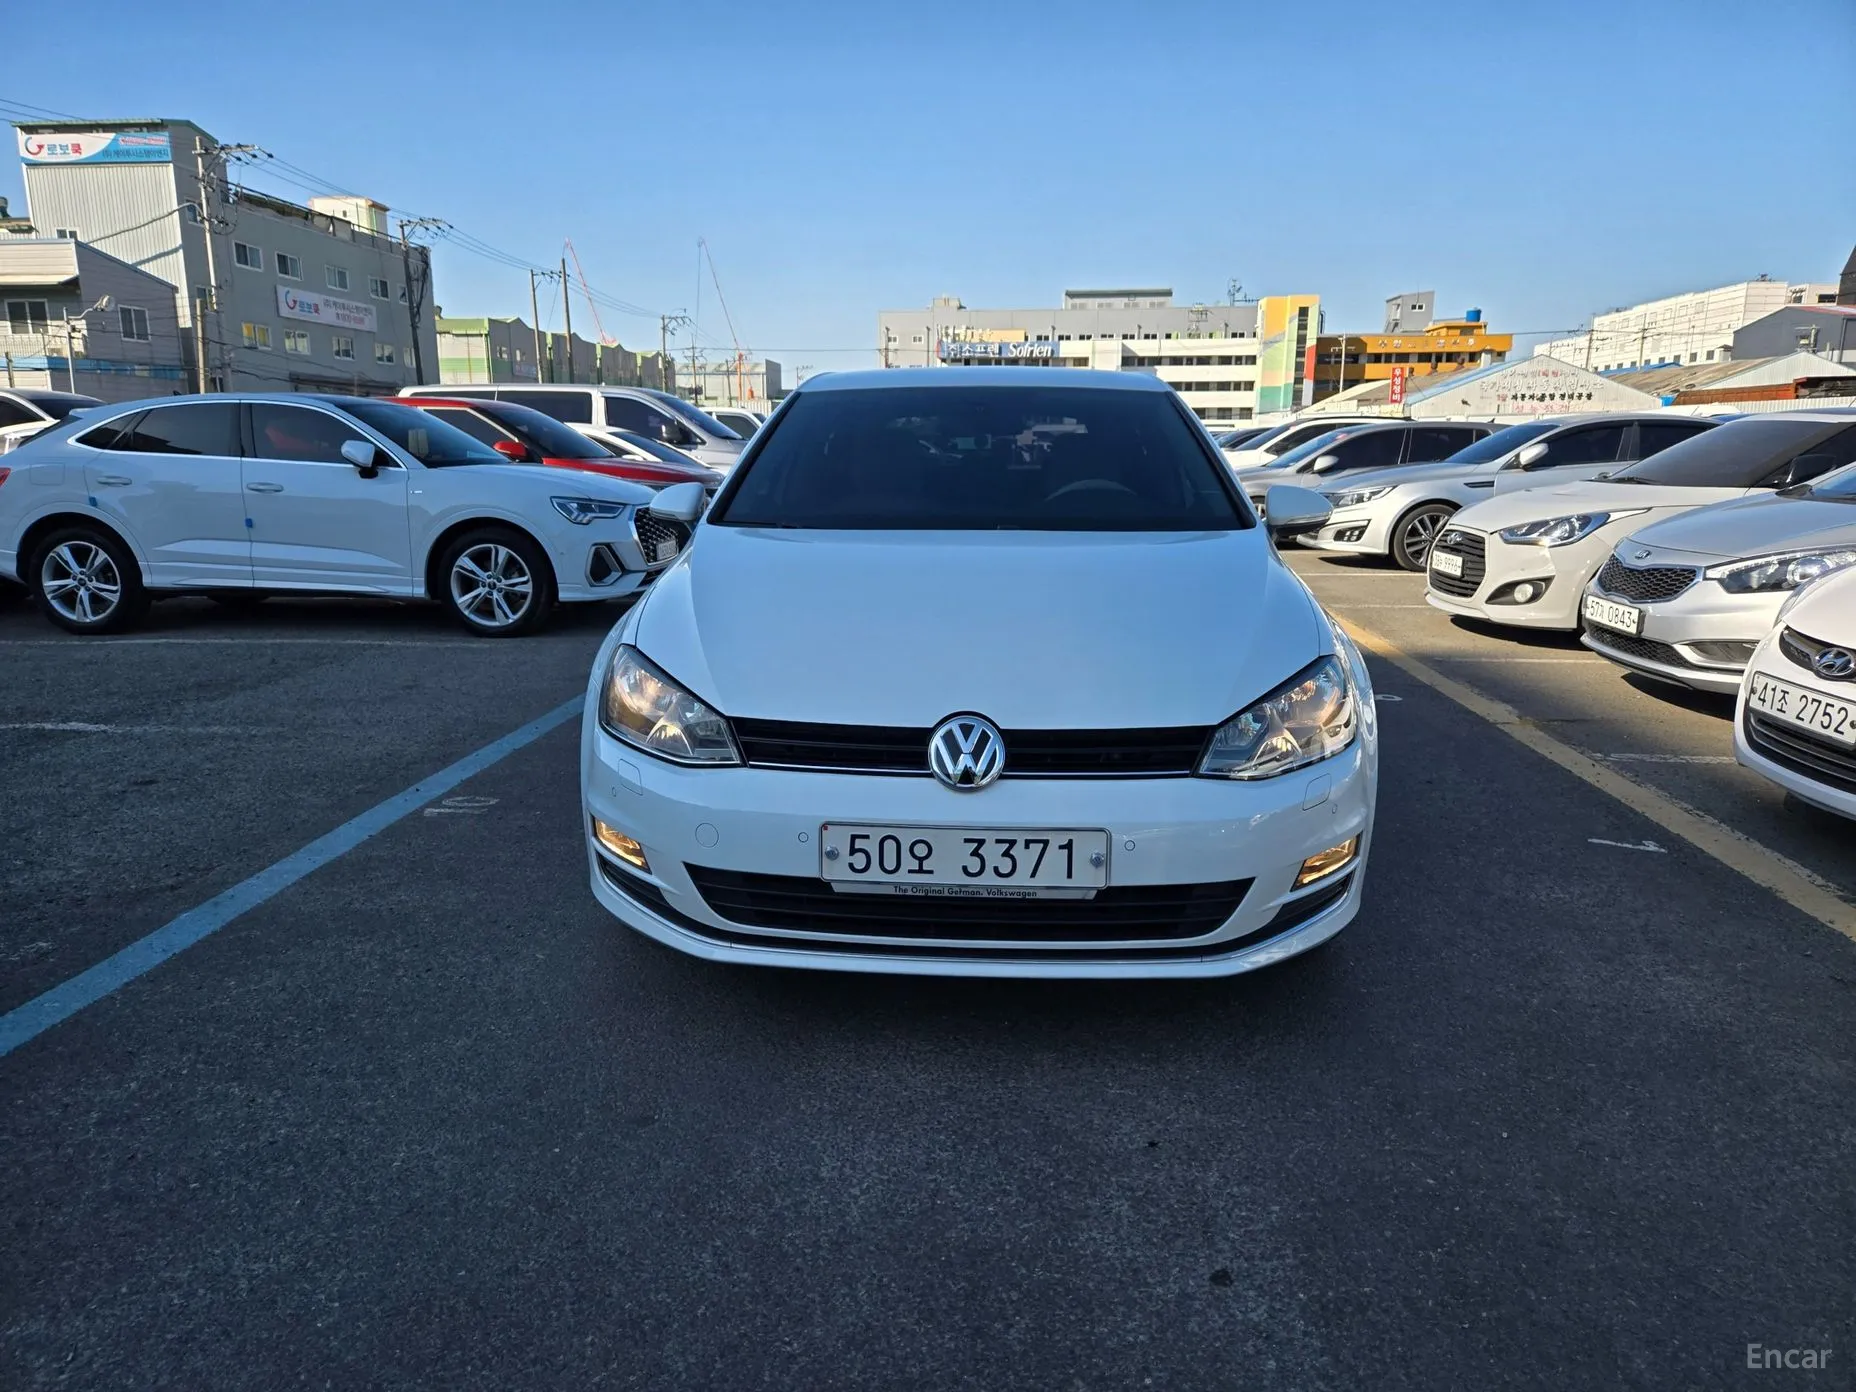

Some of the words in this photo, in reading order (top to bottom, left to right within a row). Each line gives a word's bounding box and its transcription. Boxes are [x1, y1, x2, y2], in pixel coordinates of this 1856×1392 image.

[47, 143, 82, 155] 로보쿡
[298, 300, 320, 315] 로보쿡
[1392, 368, 1403, 402] 우성정비
[1608, 606, 1632, 628] 0843
[1757, 681, 1790, 714] 41조
[1795, 694, 1849, 736] 2752
[847, 833, 935, 876] 50오
[961, 837, 1074, 880] 3371
[893, 885, 909, 894] The
[910, 885, 945, 897] Original
[986, 888, 1037, 899] Volkswagen
